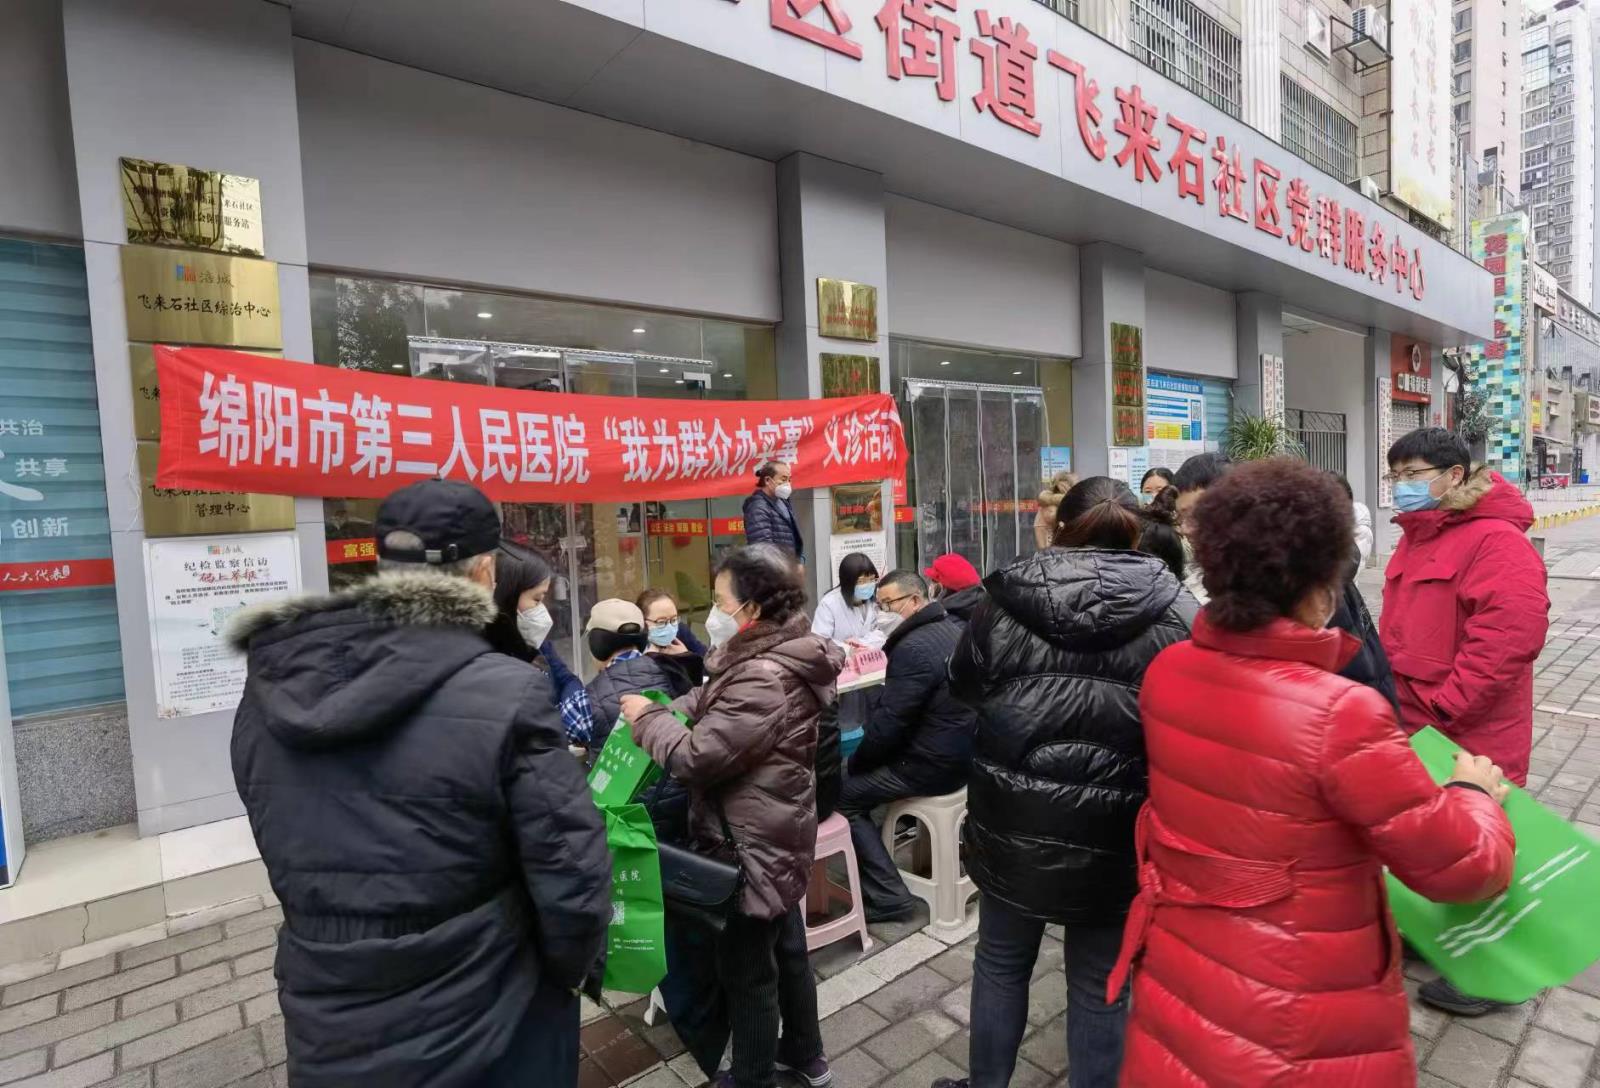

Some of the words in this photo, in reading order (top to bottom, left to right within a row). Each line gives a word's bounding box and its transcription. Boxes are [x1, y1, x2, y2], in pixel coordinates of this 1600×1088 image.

[138, 295, 272, 318] 飞来石社区综治中心
[199, 371, 590, 485] 绵阳市第三人民医院
[15, 458, 69, 477] 共享
[194, 501, 251, 518] 管理中心
[11, 517, 69, 539] 创新
[343, 542, 376, 558] 富强
[184, 556, 269, 572] 纪检监察信访
[3, 567, 67, 583] 人大代表
